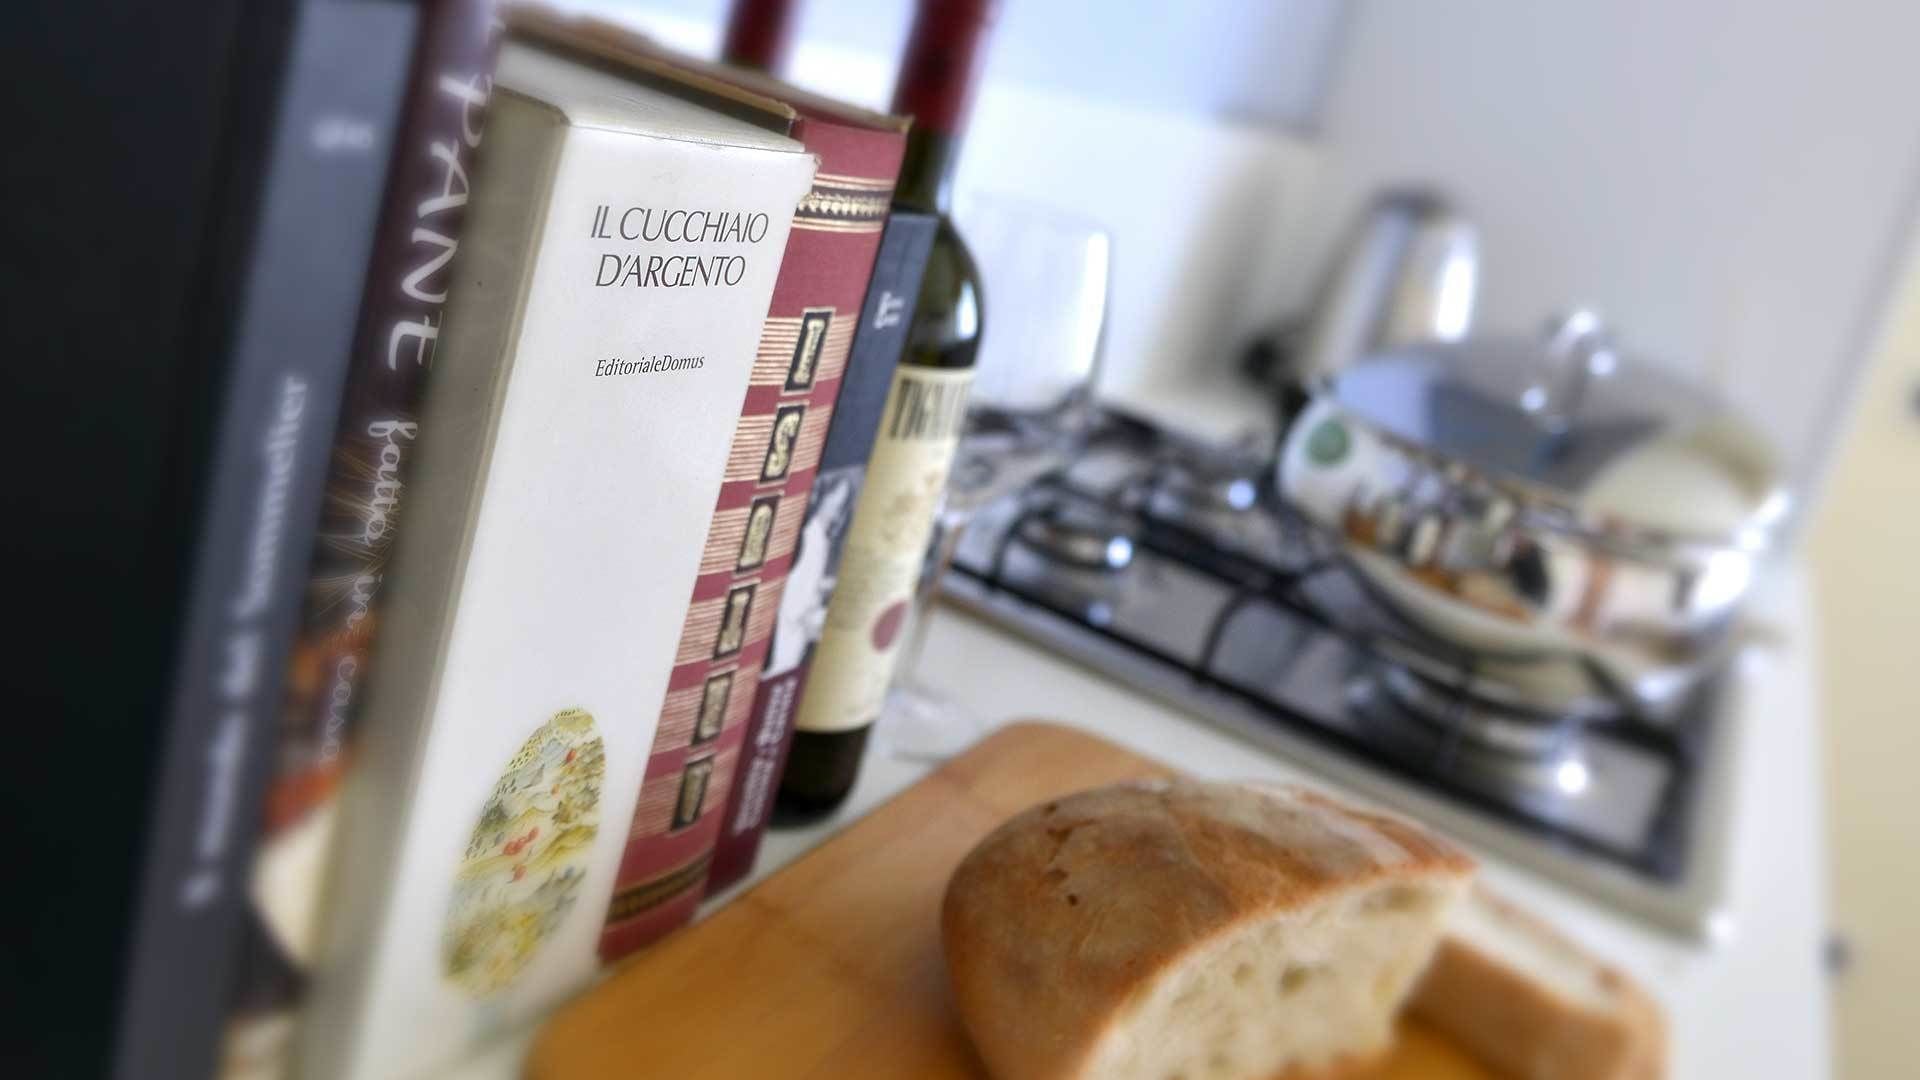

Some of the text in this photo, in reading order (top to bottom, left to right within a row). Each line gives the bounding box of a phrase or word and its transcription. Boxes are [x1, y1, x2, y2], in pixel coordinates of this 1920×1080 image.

[590, 204, 769, 244] IL CUCCHIAIO
[595, 253, 746, 288] D'ARGENTO
[320, 73, 493, 766] PANE fatto in casa
